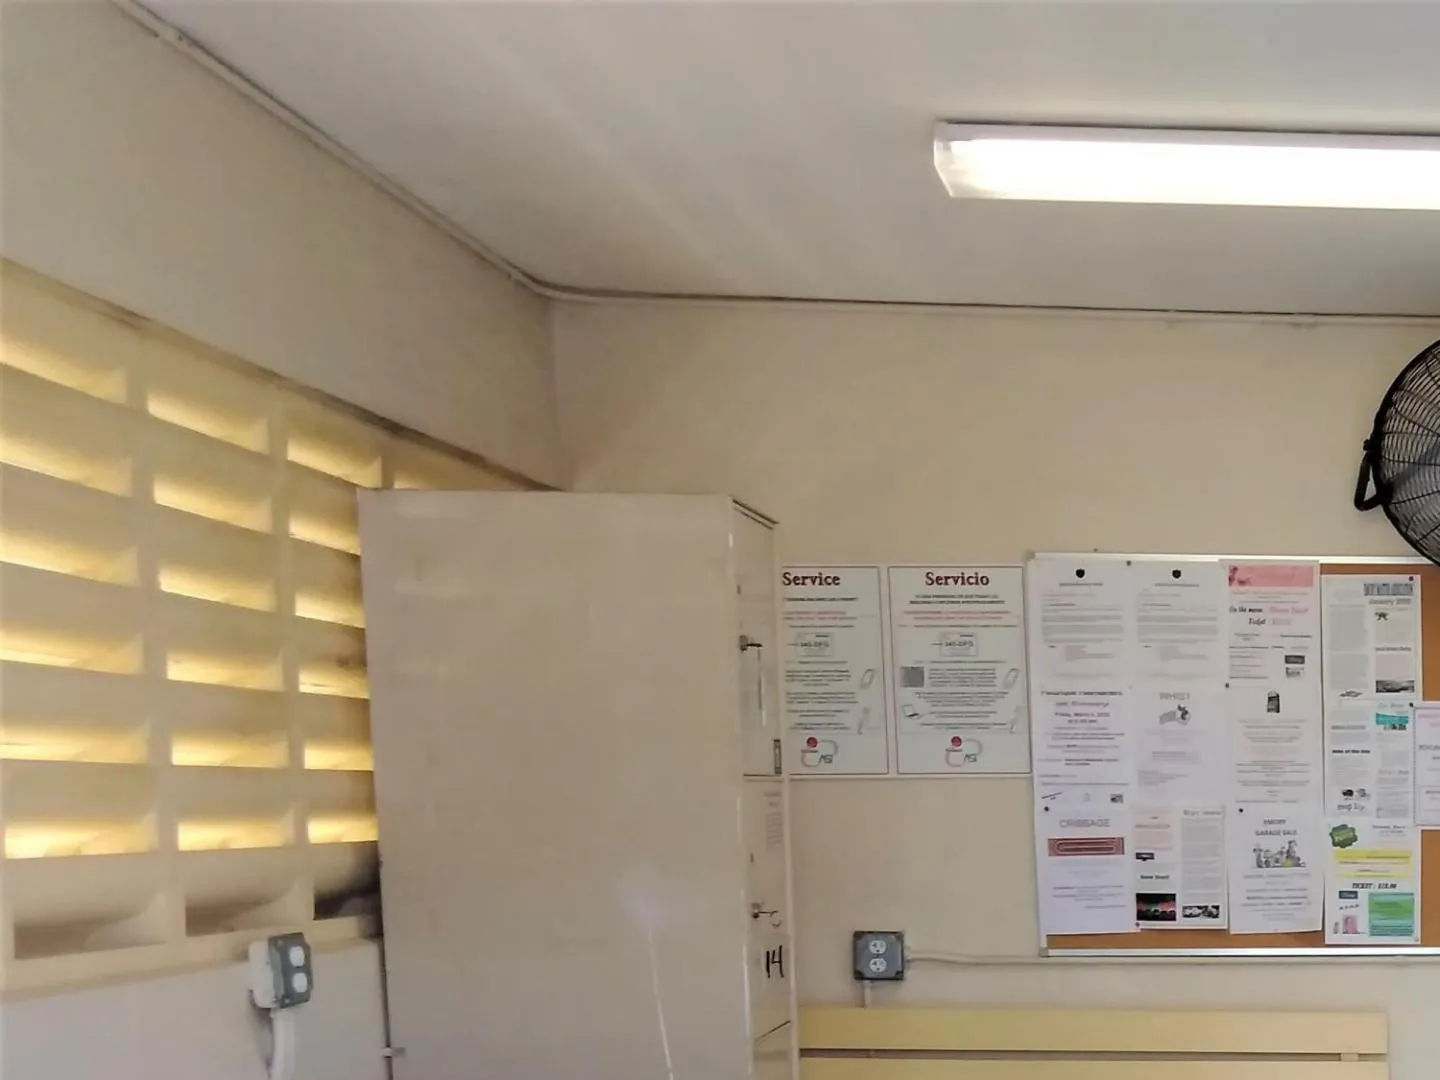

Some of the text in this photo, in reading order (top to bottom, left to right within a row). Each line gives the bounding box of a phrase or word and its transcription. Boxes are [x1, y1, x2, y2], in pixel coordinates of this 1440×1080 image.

[782, 571, 841, 586] Service
[925, 571, 990, 586] Servicio
[765, 944, 785, 979] 14
